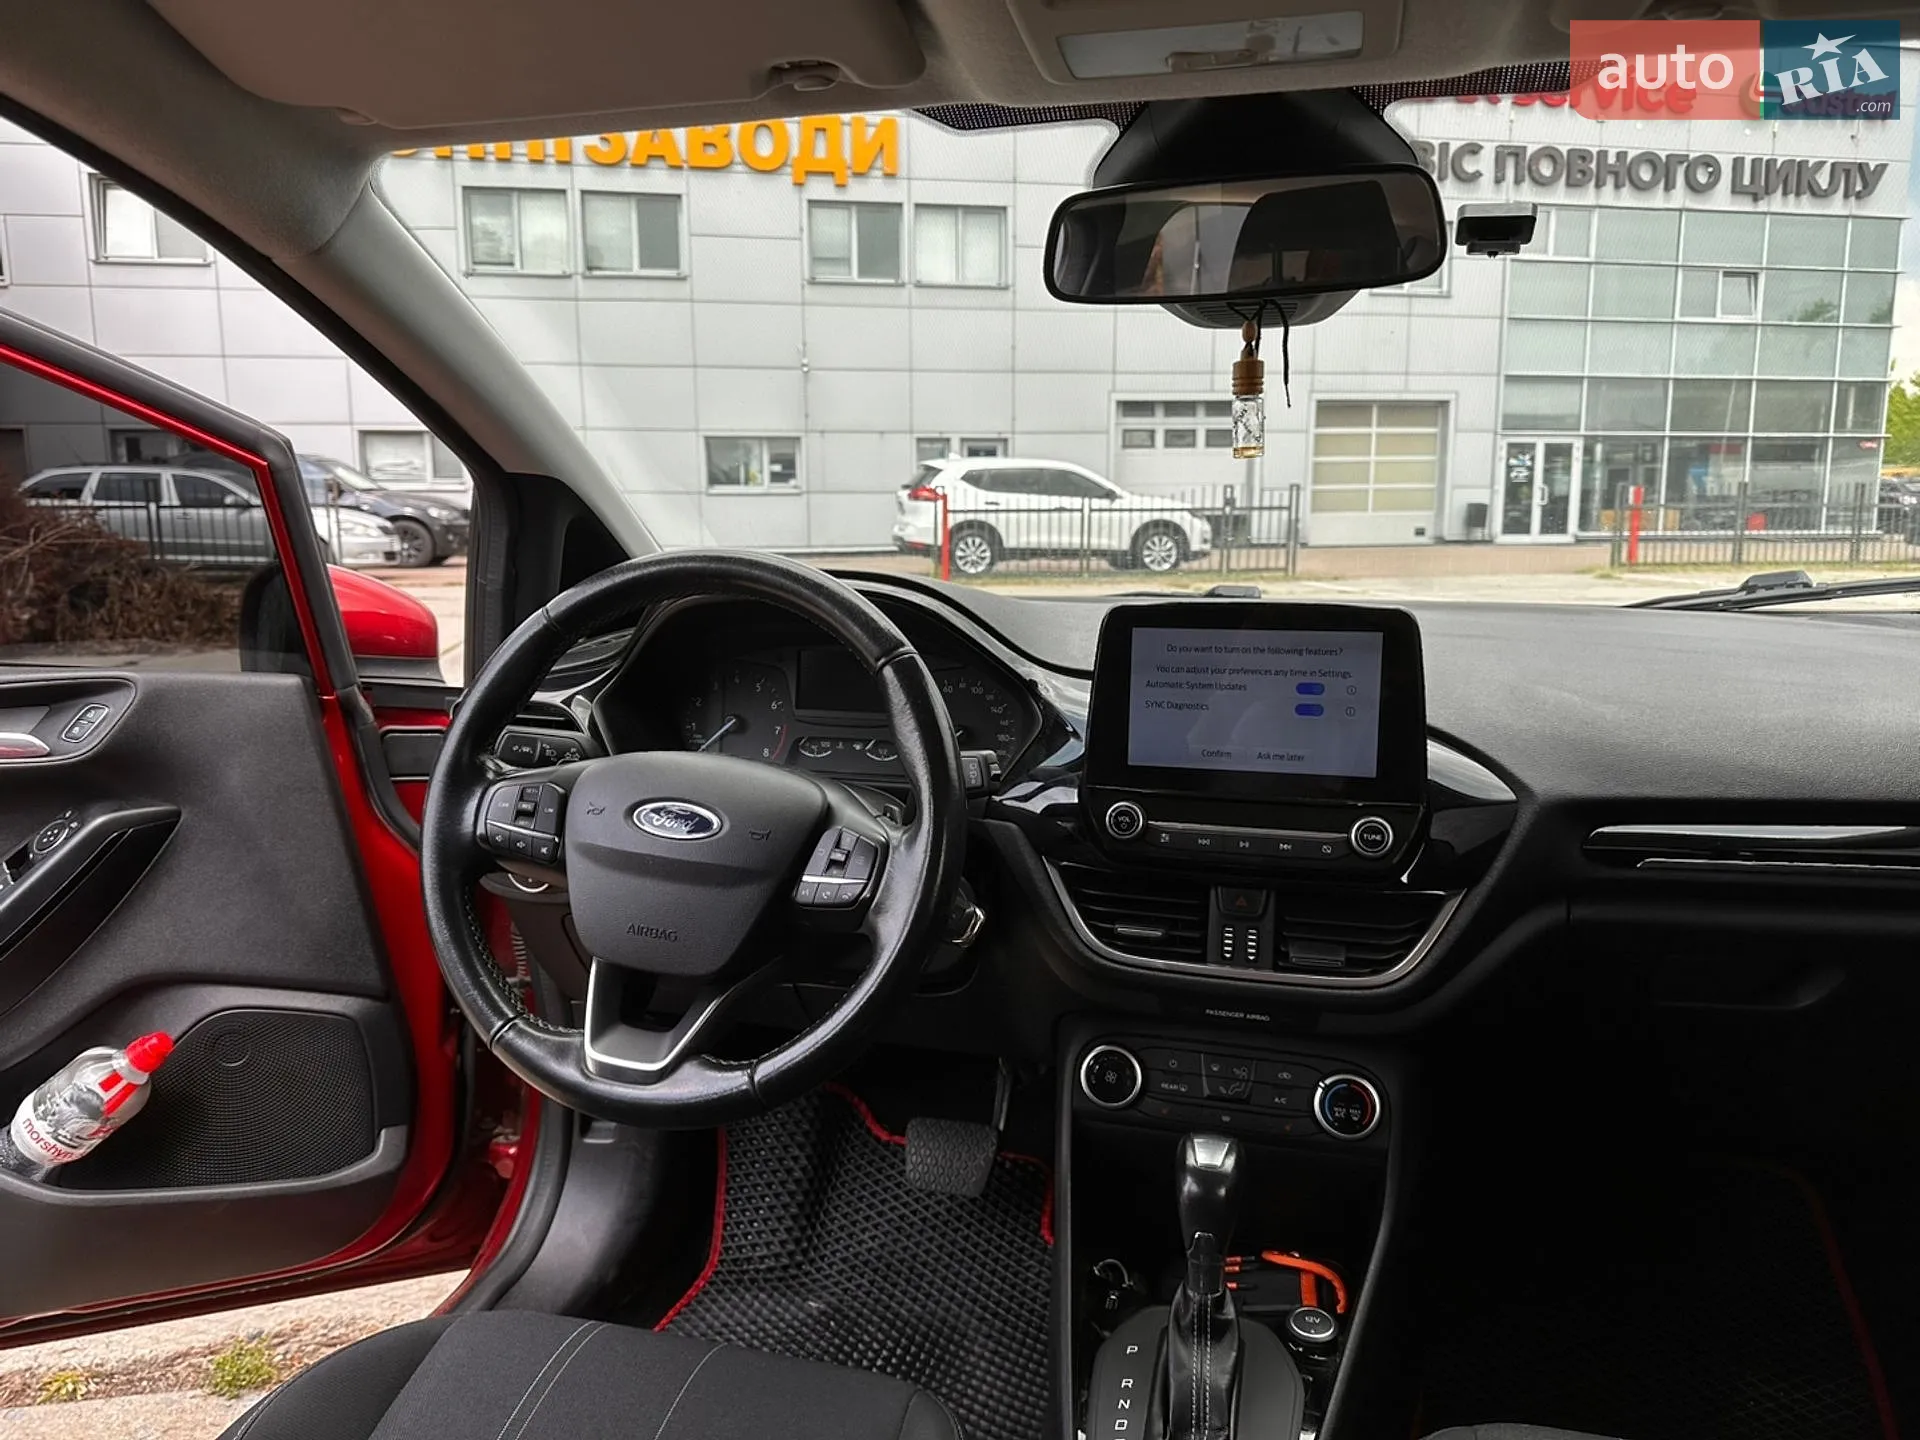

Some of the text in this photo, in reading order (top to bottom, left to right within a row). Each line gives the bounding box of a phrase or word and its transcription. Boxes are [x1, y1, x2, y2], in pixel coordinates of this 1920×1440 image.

[1494, 144, 1722, 194] ПОВНОГО
[1731, 156, 1889, 202] ЦИКЛУ
[1166, 643, 1178, 653] Do
[1179, 645, 1192, 656] you
[1193, 646, 1213, 654] want
[1253, 646, 1266, 655] the
[1267, 646, 1304, 657] following
[1145, 680, 1248, 691] Automatic System Updates
[770, 700, 778, 710] 6
[1145, 700, 1210, 711] SYNC Diagnostics
[774, 726, 781, 735] 7
[762, 748, 770, 758] 8
[1200, 748, 1232, 759] Confirm
[1257, 751, 1271, 760] Ask
[649, 806, 699, 832] Ford
[626, 922, 679, 943] AIRBAG
[1205, 1008, 1271, 1022] PASSENGER AIRBAG
[1125, 1344, 1139, 1355] P
[1120, 1377, 1134, 1389] R
[1117, 1398, 1131, 1410] N
[1114, 1418, 1128, 1431] D
